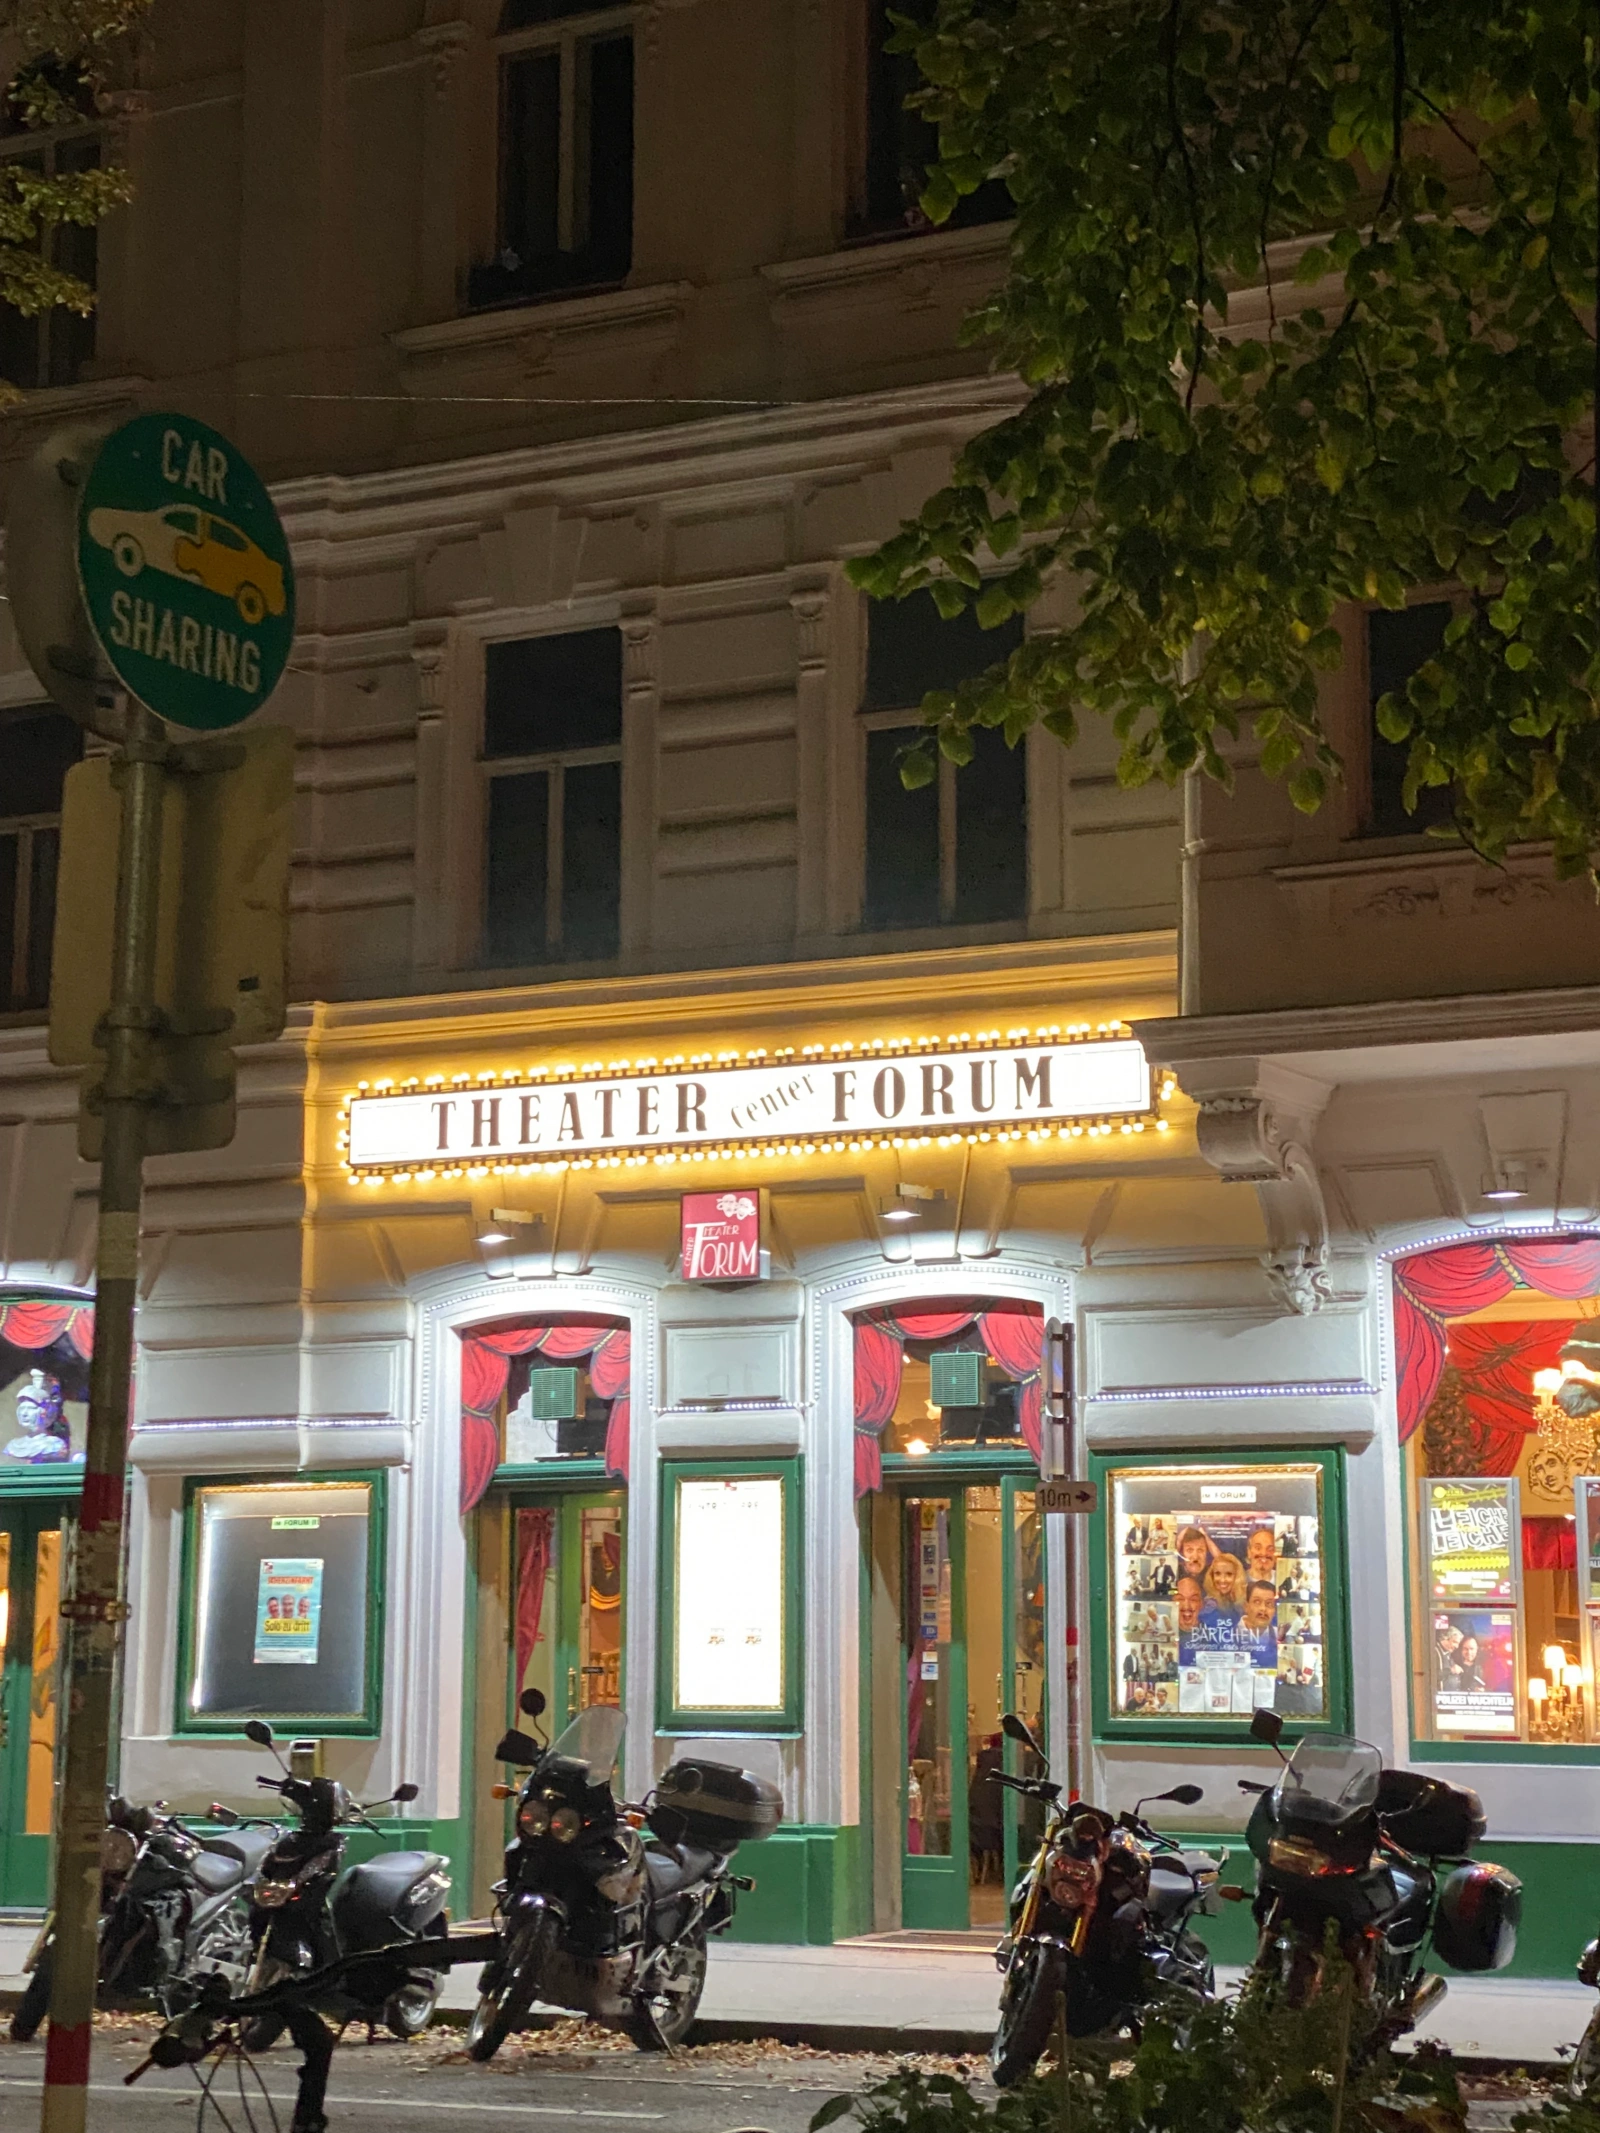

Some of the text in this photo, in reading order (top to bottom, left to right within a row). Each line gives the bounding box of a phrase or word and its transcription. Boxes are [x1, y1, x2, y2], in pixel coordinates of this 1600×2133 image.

[162, 429, 228, 502] CAR
[111, 590, 261, 694] SHARING
[431, 1082, 708, 1150] THEATER
[832, 1055, 1054, 1122] FORUM
[683, 1236, 694, 1267] CENTER
[1039, 1488, 1071, 1507] 10m
[1214, 1491, 1247, 1499] FORUM
[1190, 1622, 1260, 1644] BÄRTCHEN
[1217, 1618, 1233, 1627] DAS
[1436, 1695, 1467, 1705] POLIZEI
